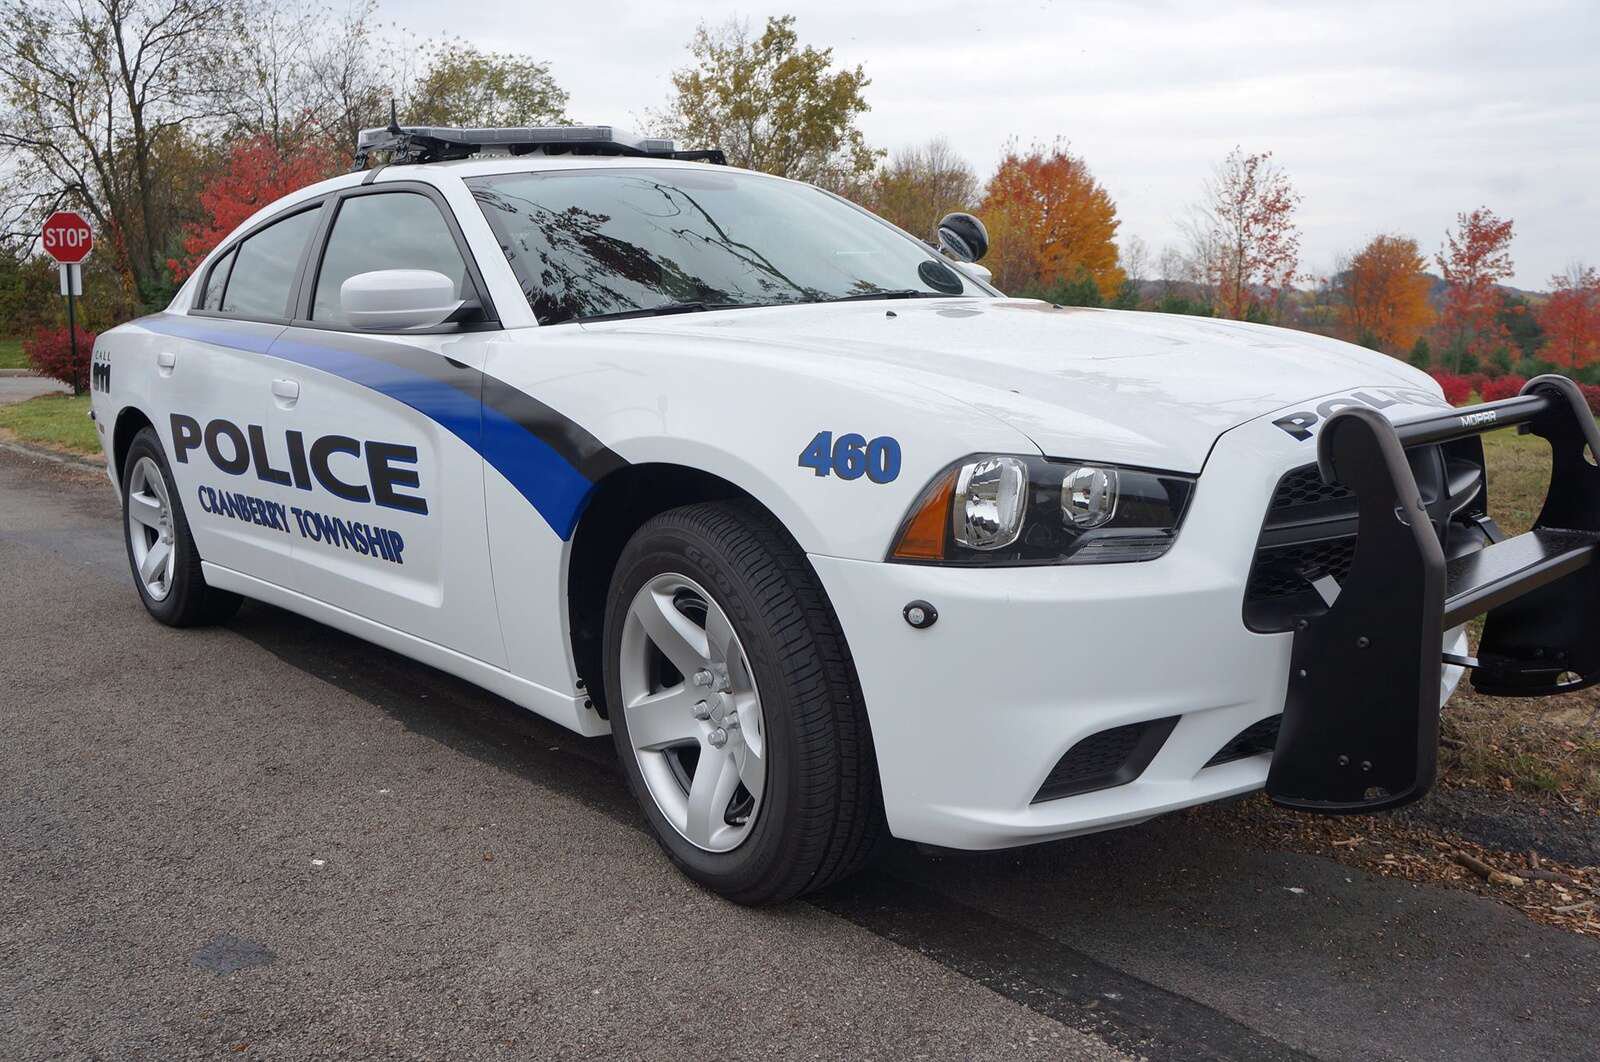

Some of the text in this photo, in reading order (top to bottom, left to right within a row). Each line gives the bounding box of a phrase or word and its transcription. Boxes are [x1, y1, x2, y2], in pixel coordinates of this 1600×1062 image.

[45, 228, 89, 247] STOP
[1460, 410, 1496, 428] MOPAR
[170, 413, 428, 516] POLICE
[798, 430, 902, 485] 460
[198, 485, 405, 564] CRANBERRY TOWNSHIP
